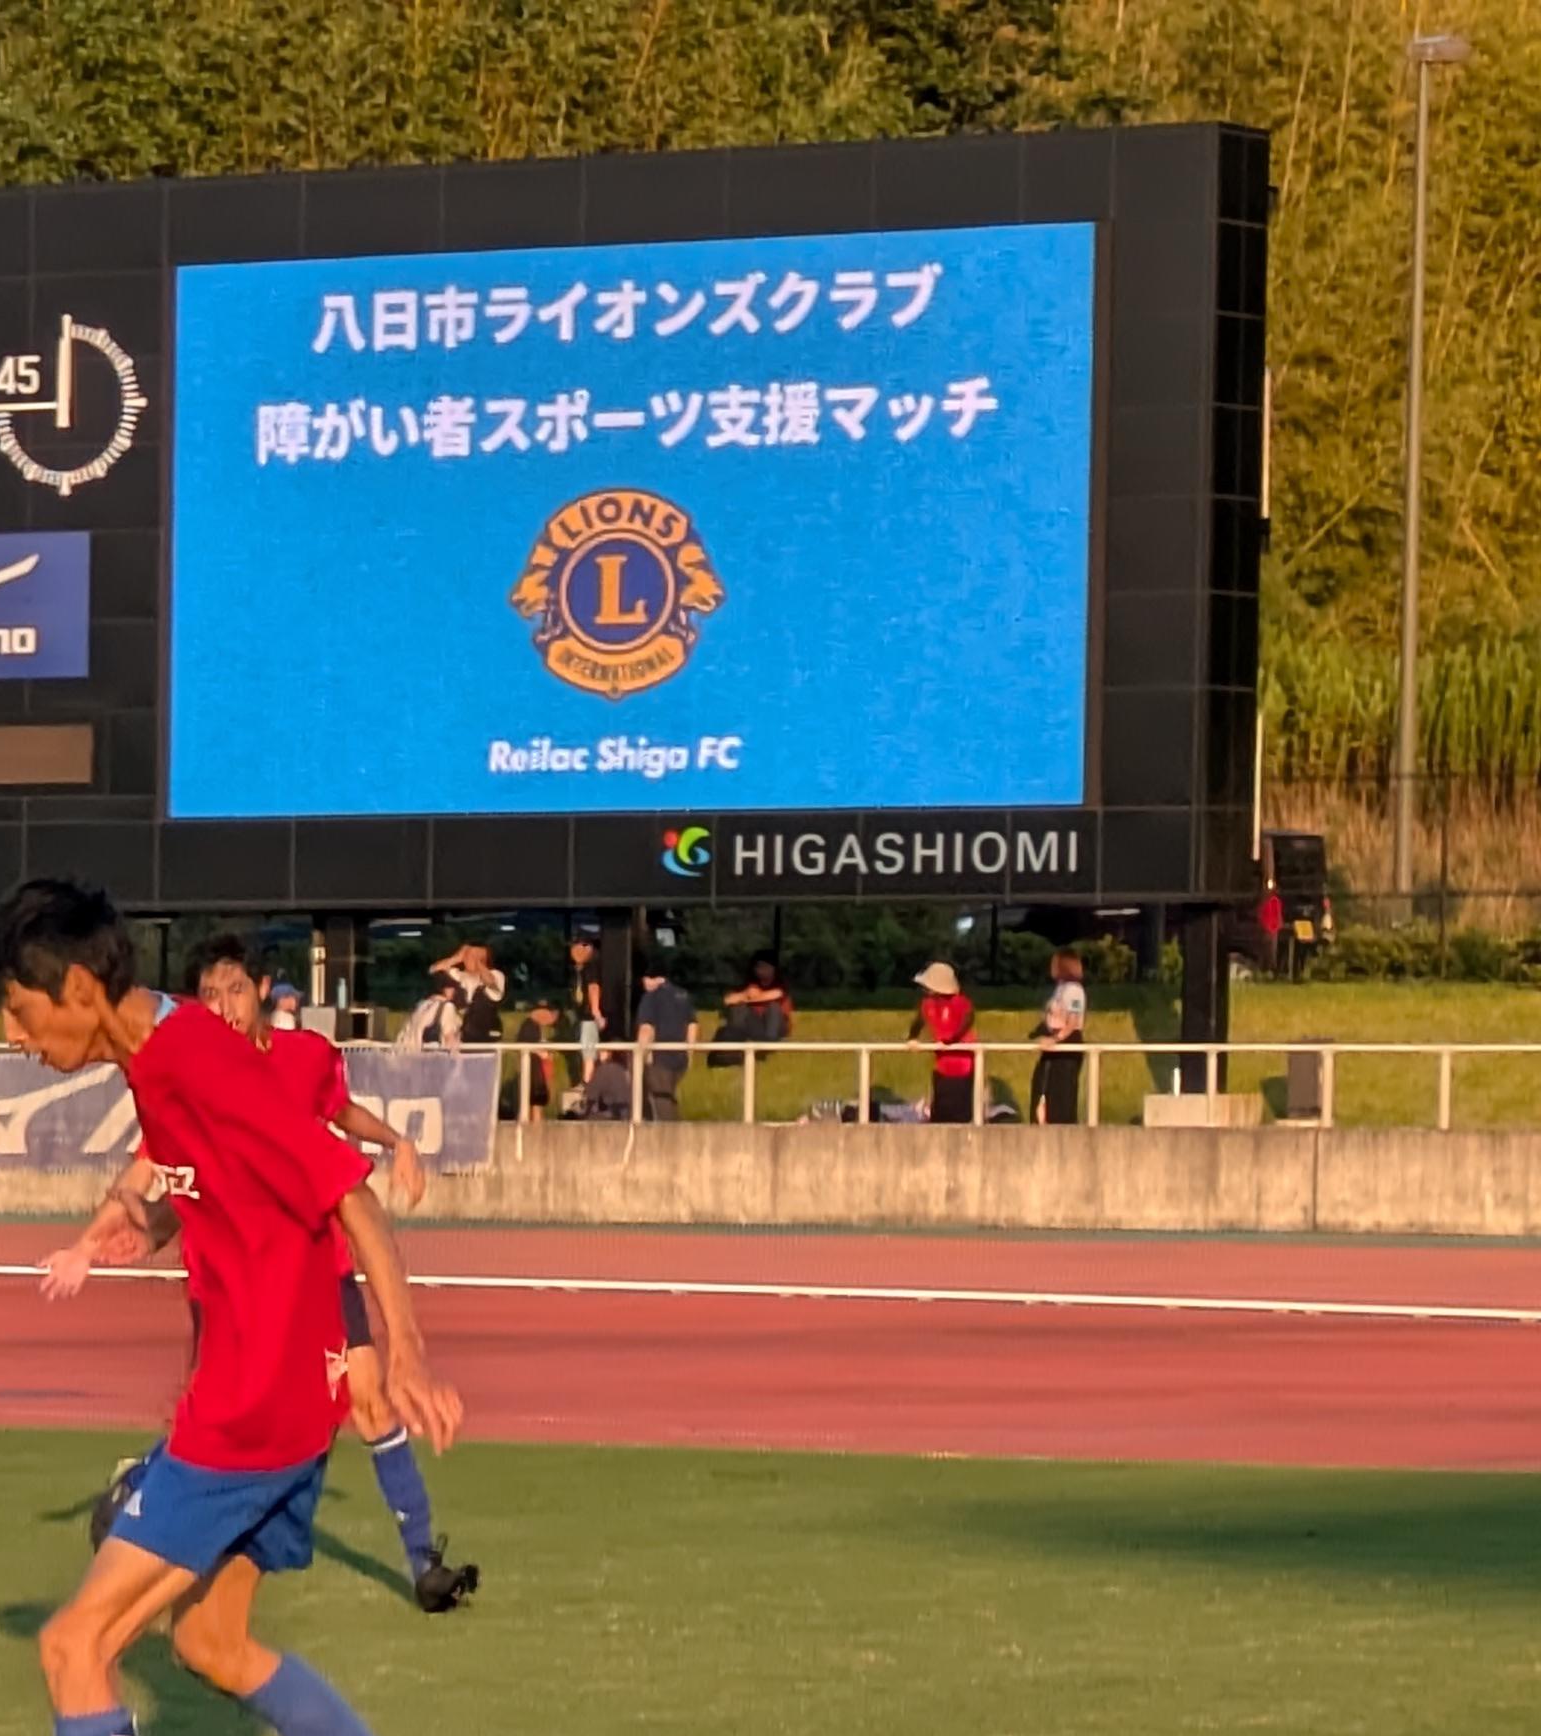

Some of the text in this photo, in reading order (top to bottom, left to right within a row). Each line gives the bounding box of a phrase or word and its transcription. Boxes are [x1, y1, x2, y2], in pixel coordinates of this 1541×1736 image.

[312, 262, 943, 354] 八日市ライオンズクラブ
[255, 376, 999, 464] 障がい者スポーツ支援マッチ
[556, 497, 681, 542] LIONS
[594, 553, 648, 625] L
[490, 736, 742, 778] Reilac Shiga FC
[734, 831, 1078, 876] HIGASHIOMI
